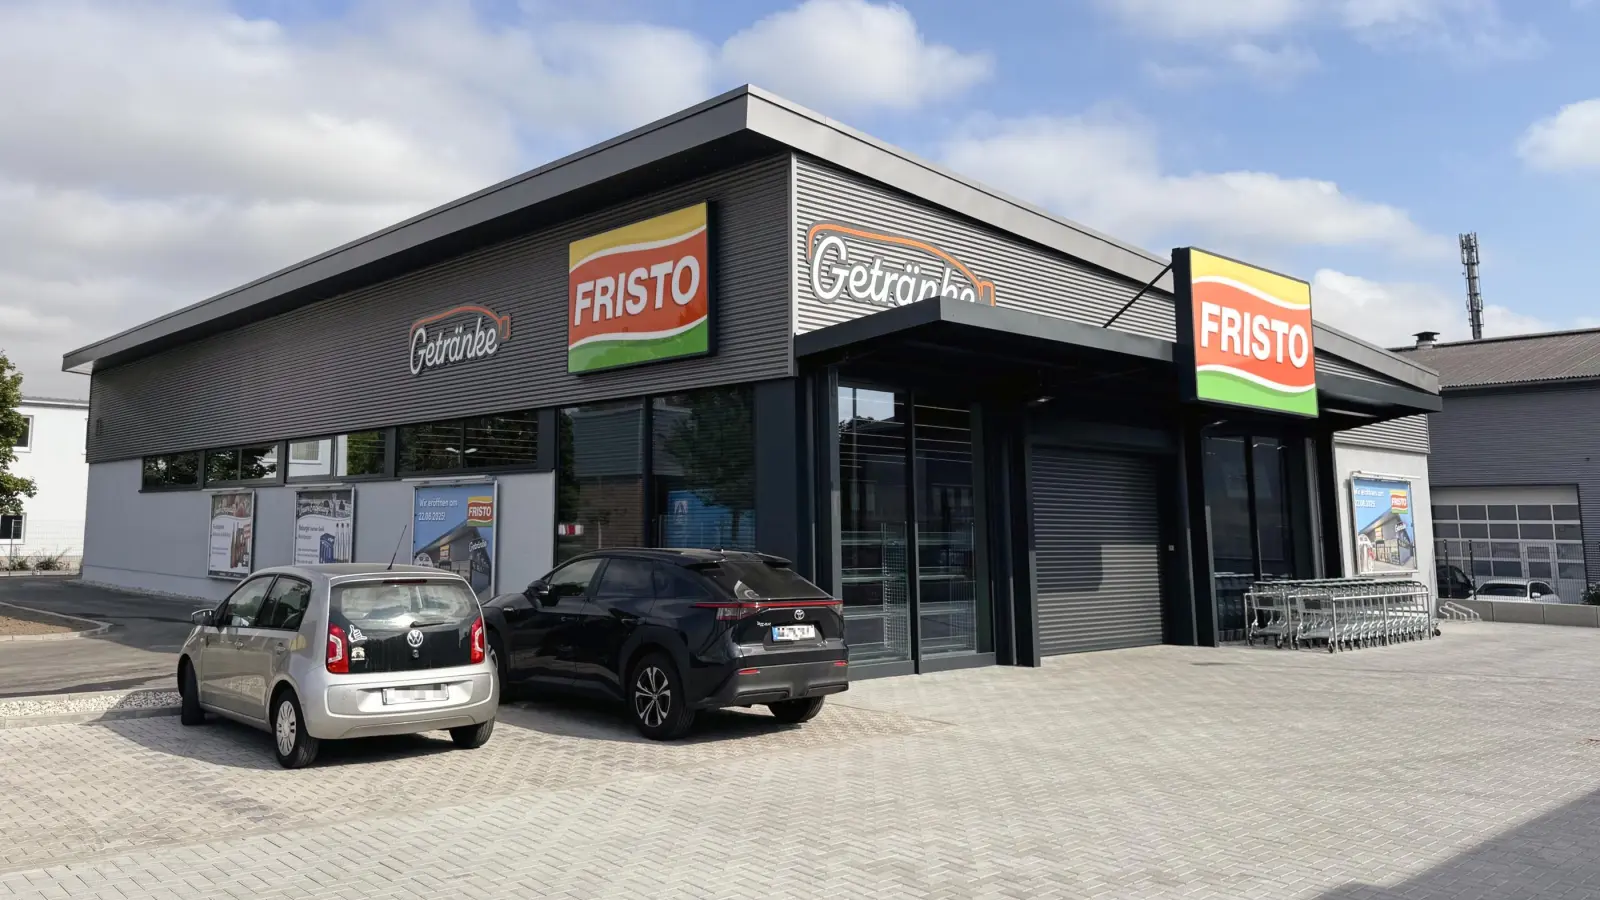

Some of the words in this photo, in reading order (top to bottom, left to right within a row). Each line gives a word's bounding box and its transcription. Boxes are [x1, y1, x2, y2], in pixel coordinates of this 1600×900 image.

[574, 255, 700, 326] FRISTO
[410, 317, 498, 375] Getränke
[1200, 301, 1309, 369] FRISTO
[419, 498, 428, 507] Wir
[428, 497, 449, 507] eröffnen
[468, 506, 492, 517] FRISTO
